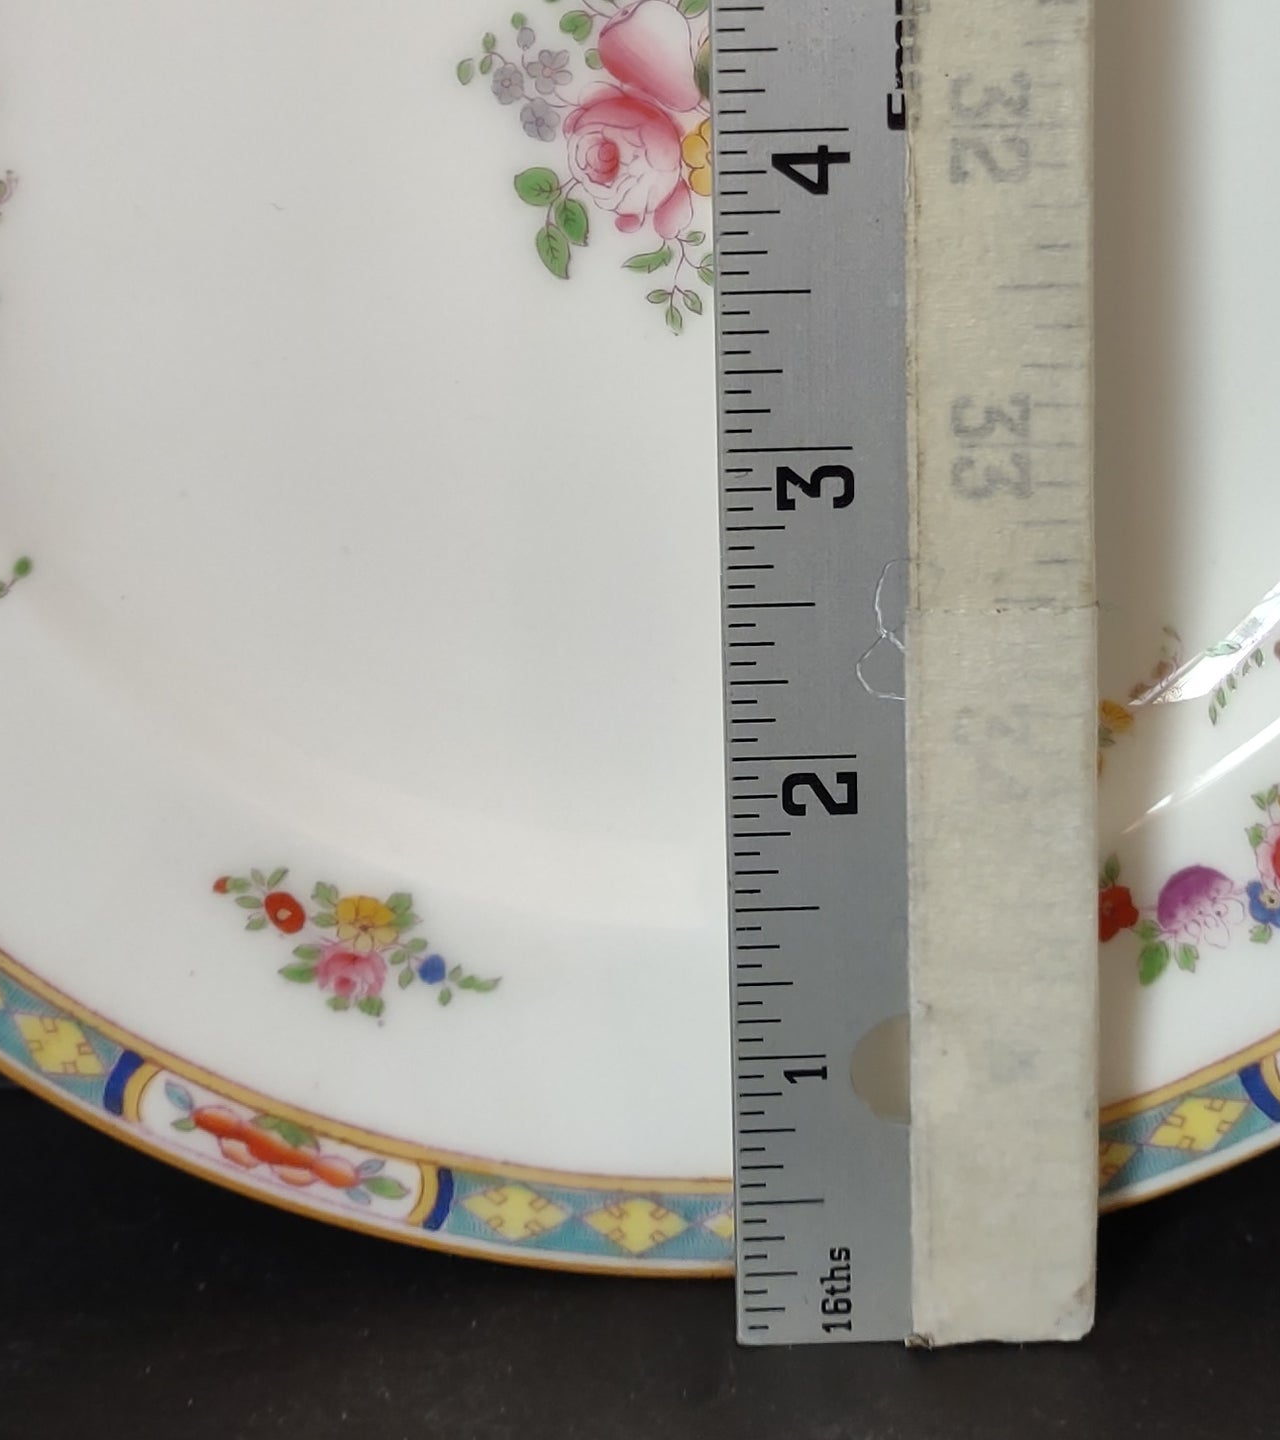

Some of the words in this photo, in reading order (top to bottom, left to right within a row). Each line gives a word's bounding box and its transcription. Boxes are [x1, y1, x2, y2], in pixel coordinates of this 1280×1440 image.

[948, 71, 1031, 184] 32
[771, 145, 851, 195] 4
[949, 394, 1031, 500] 33
[776, 464, 855, 511] 3
[782, 771, 858, 817] 2
[783, 1066, 828, 1084] 1
[821, 1246, 852, 1334] 16ths
